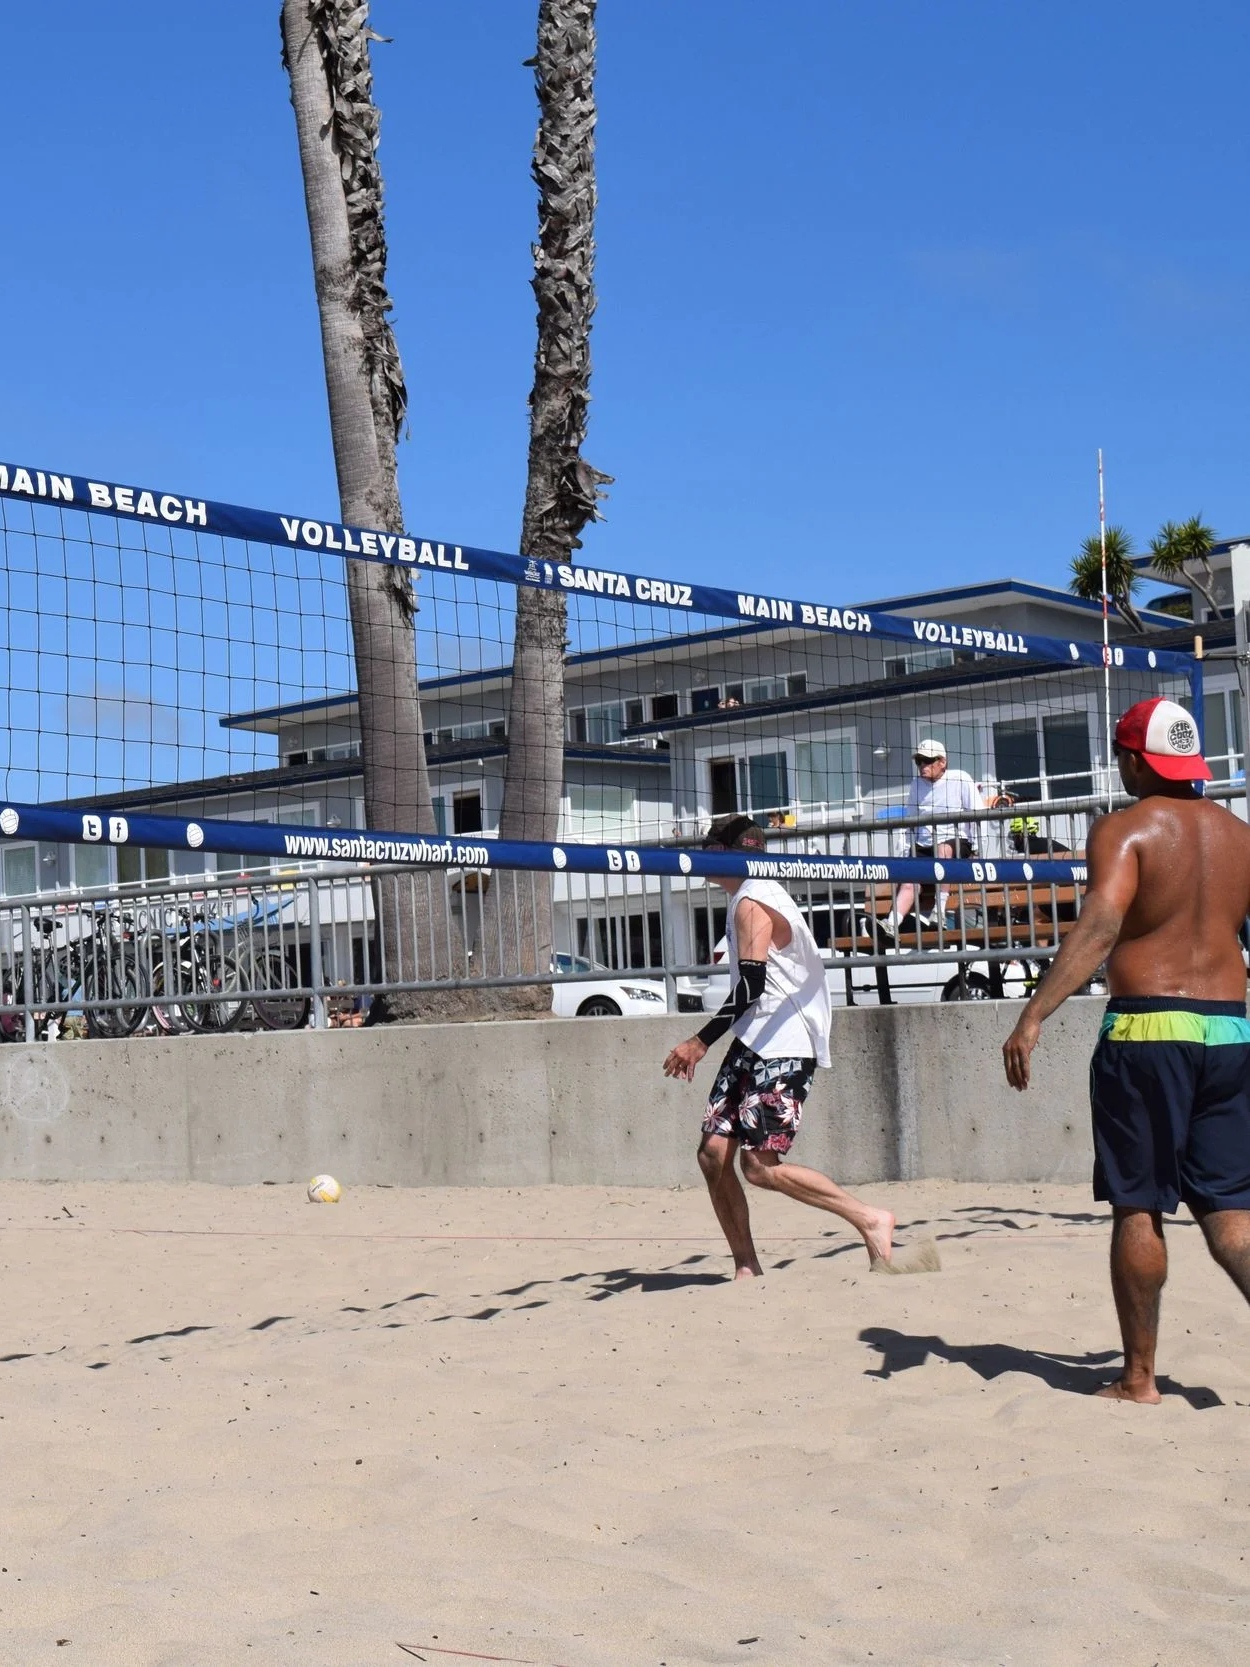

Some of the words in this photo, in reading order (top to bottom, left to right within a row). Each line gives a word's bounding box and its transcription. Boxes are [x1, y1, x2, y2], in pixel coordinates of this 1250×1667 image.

[87, 482, 207, 526] BEACH
[280, 517, 469, 571] VOLLEYBALL
[558, 565, 630, 597] SANTA
[635, 578, 693, 607] CRUZ
[737, 594, 793, 622] MAIN
[800, 604, 872, 633] BEACH
[913, 620, 1028, 654] VOLLEYBALL
[284, 834, 489, 865] www.santacruzwharf.com
[746, 860, 889, 880] www.santacruzwharf.com
